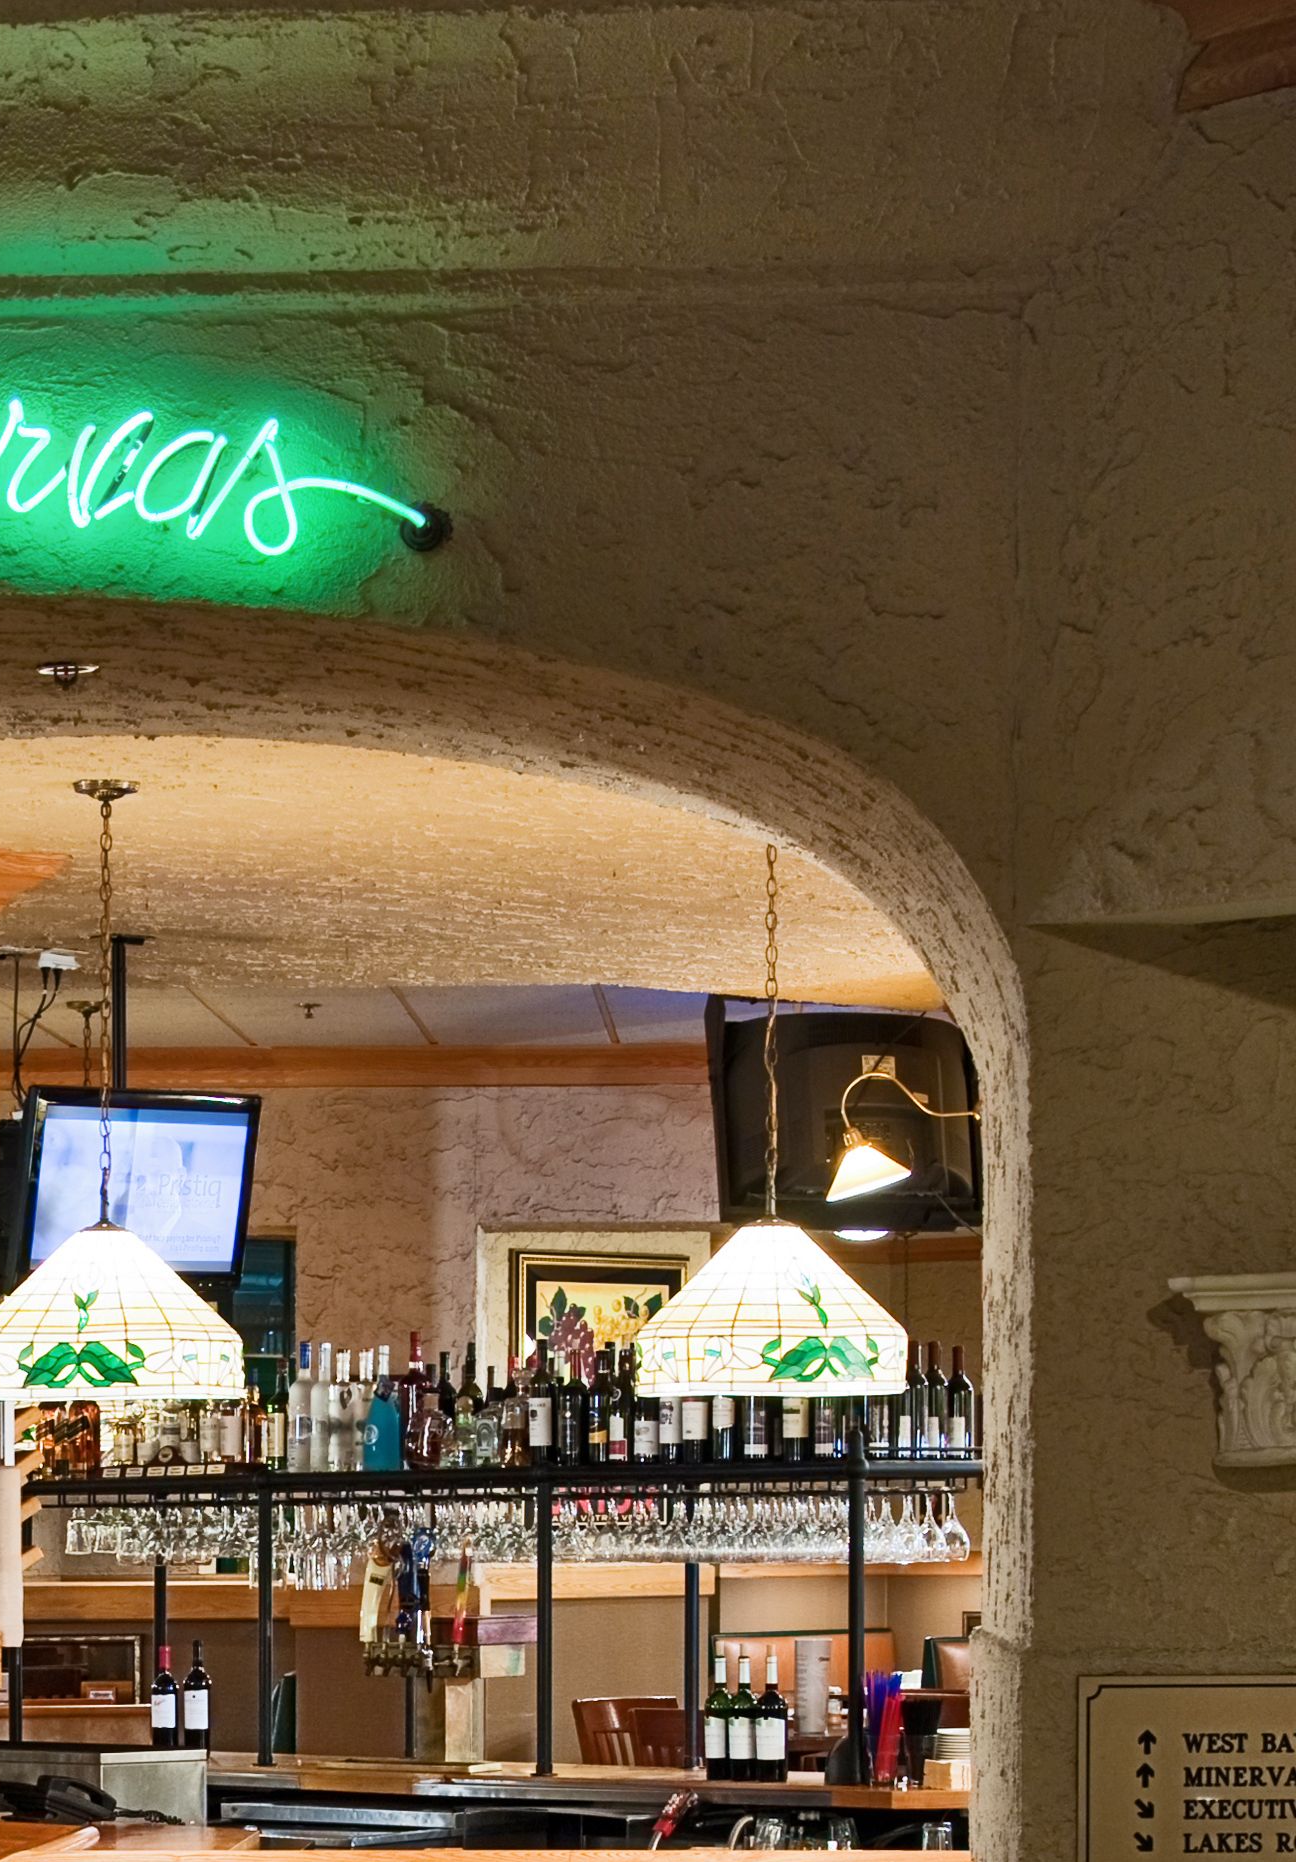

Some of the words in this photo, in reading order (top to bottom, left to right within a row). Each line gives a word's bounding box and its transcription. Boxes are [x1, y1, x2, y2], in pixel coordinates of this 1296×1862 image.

[159, 1174, 222, 1208] Pristiq
[1182, 1732, 1248, 1753] WEST
[1261, 1732, 1296, 1753] BA
[1183, 1833, 1263, 1853] LAKES
[1276, 1833, 1296, 1853] R
